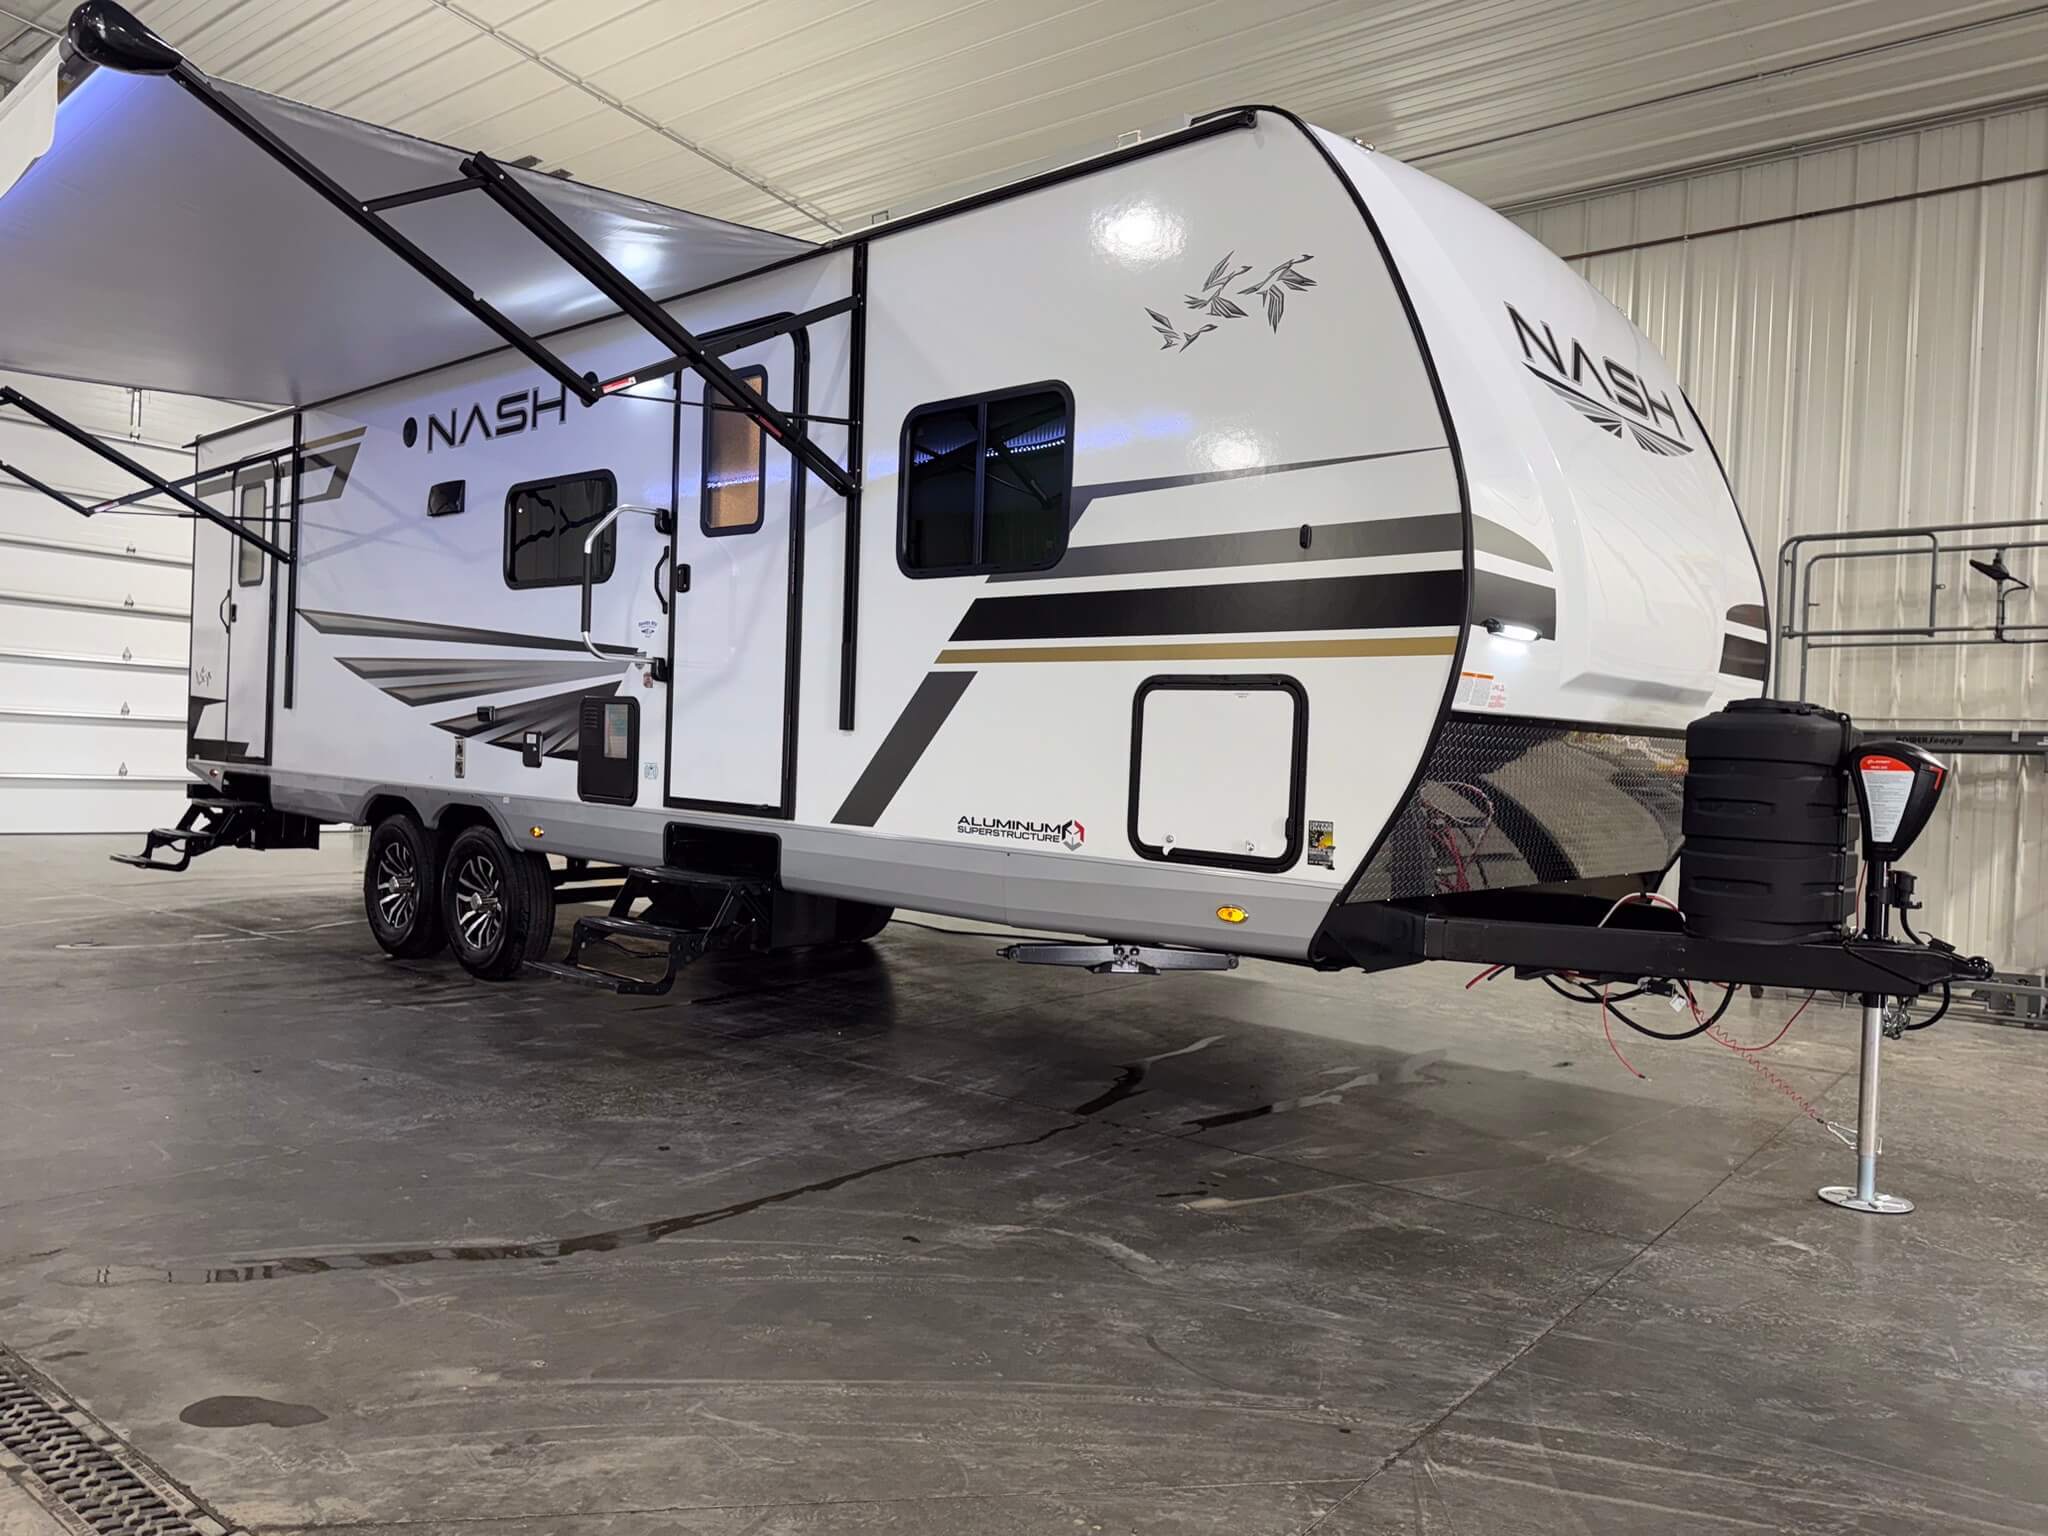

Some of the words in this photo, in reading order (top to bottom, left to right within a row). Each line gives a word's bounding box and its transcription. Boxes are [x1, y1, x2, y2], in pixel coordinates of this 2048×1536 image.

[1503, 301, 1687, 441] NASH
[427, 383, 568, 454] NASH
[957, 815, 1061, 834] ALUMINUM
[957, 825, 1061, 843] SUPERSTRUCTURE
